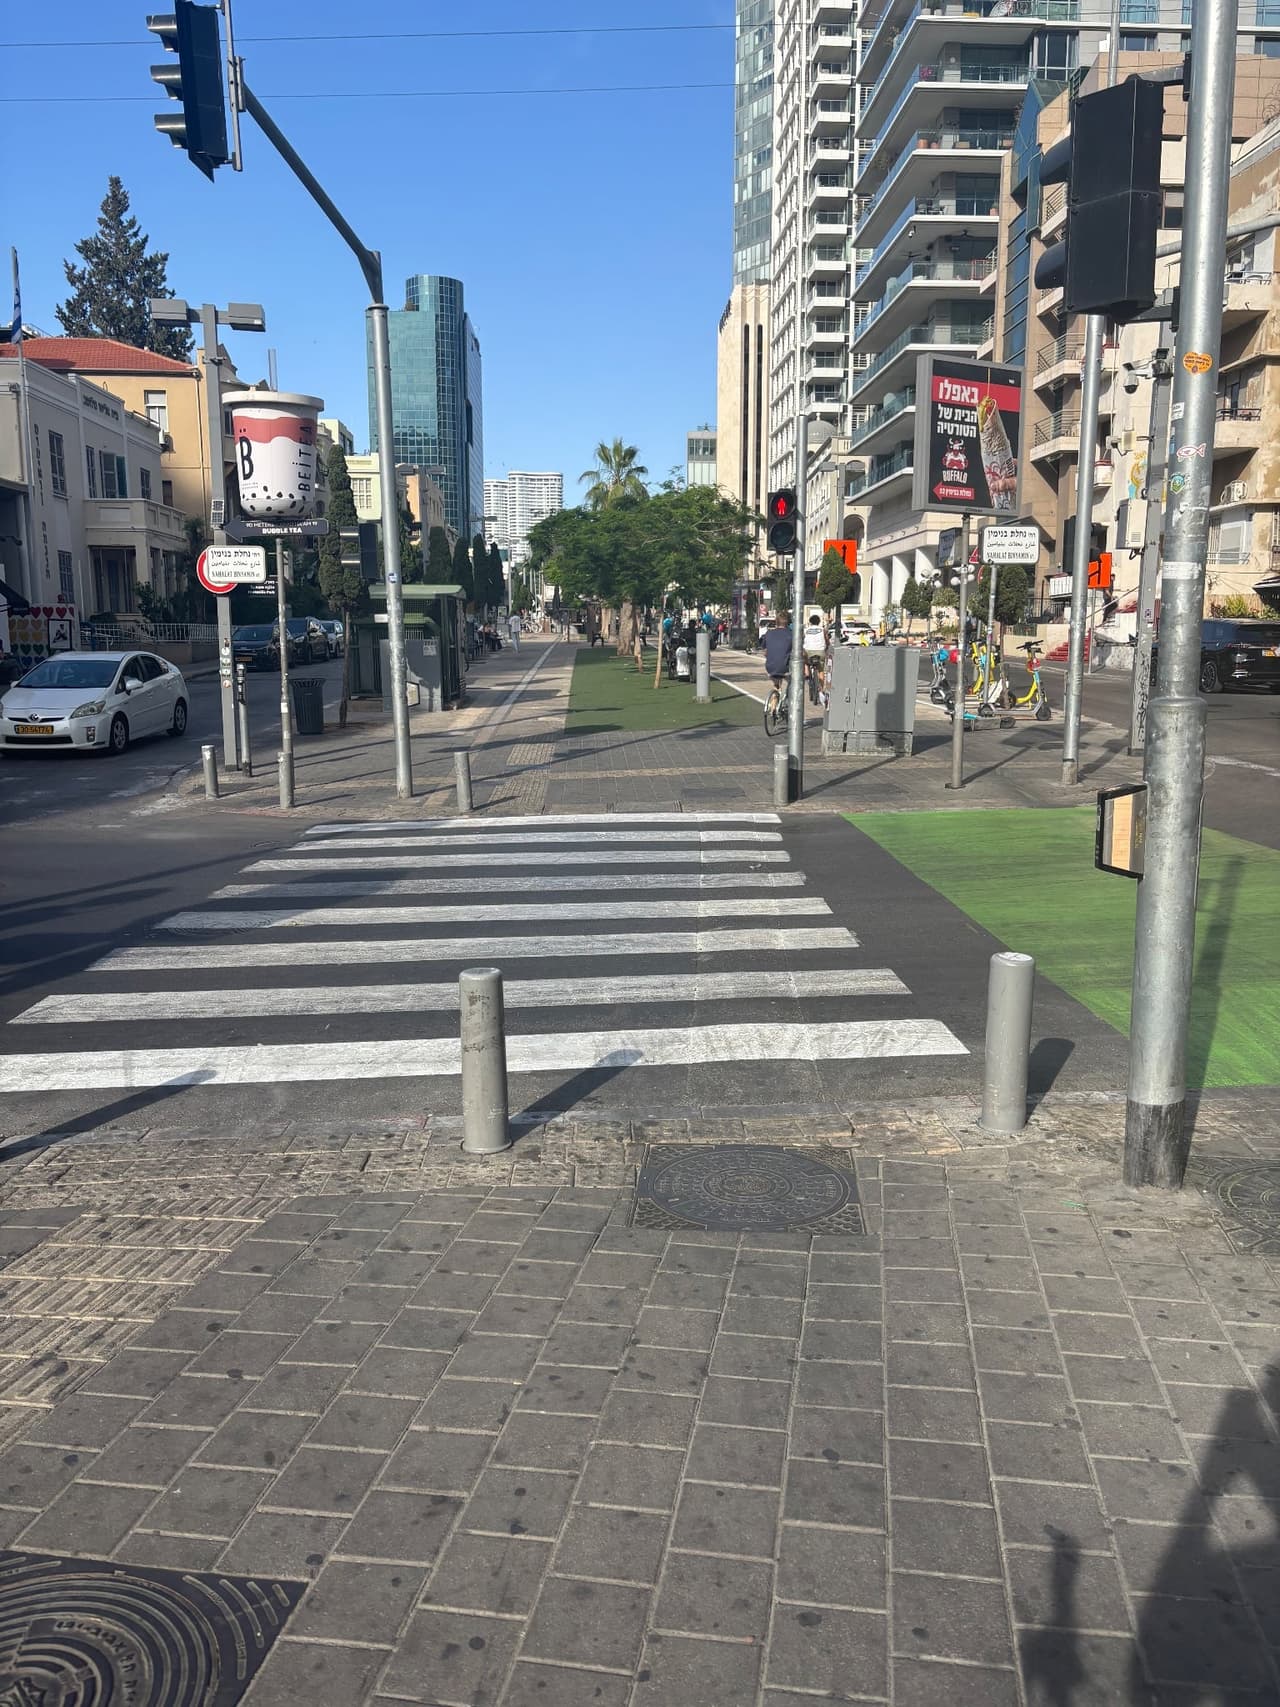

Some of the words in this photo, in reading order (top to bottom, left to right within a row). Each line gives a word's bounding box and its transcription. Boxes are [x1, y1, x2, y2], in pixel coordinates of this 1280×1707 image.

[938, 379, 979, 404] באפלו
[938, 403, 953, 420] של
[954, 408, 978, 423] הבית
[937, 421, 977, 438] הטורטיה
[942, 470, 968, 484] BUFFALO
[988, 530, 1008, 539] בנימין
[1010, 529, 1027, 538] נחלת
[210, 550, 232, 559] בנימין
[234, 549, 251, 558] נחלת
